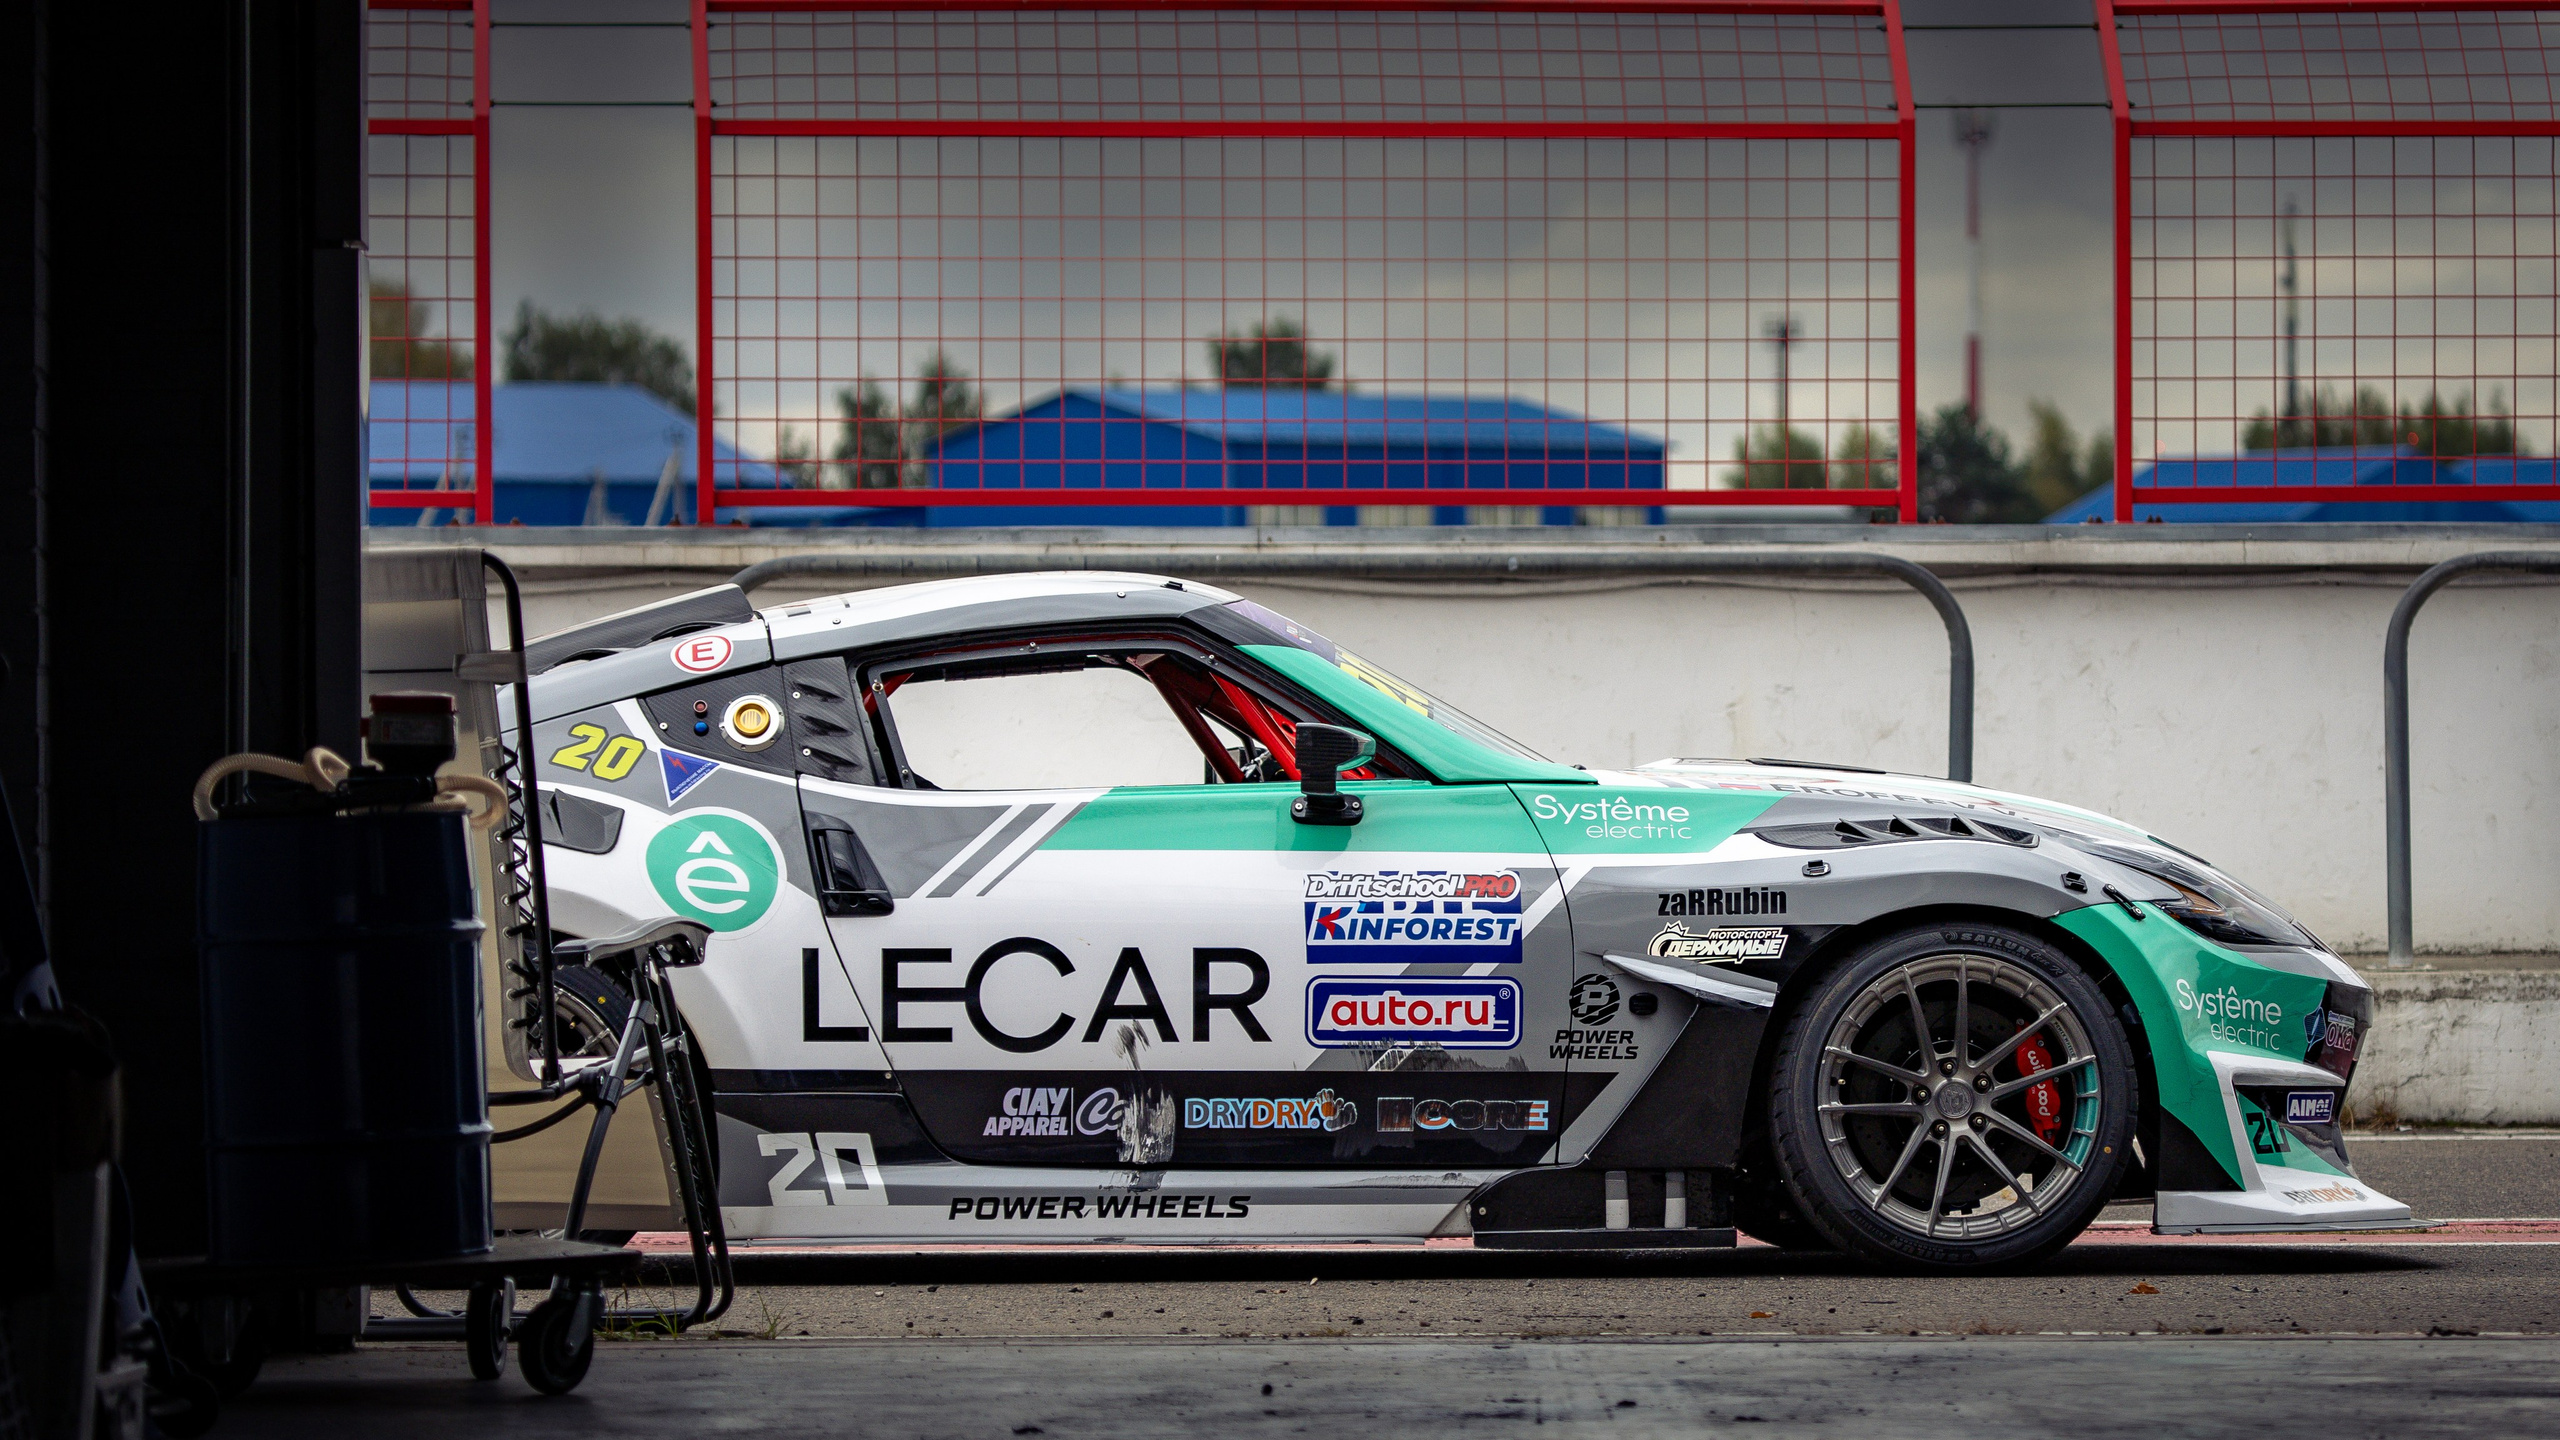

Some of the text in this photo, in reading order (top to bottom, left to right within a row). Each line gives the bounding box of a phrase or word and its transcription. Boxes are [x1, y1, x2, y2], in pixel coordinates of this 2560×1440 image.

[691, 641, 715, 662] E
[551, 723, 646, 781] 20
[1534, 794, 1690, 825] Système
[1586, 821, 1692, 839] electric
[1658, 887, 1787, 916] zaRRubin
[1313, 906, 1518, 941] KINFOREST
[1708, 930, 1778, 940] МОТОРСПОРТ
[1960, 932, 2030, 955] SAILUN
[802, 936, 1272, 1054] LECAR
[2176, 978, 2282, 1025] Système
[1331, 996, 1489, 1026] auto.ru
[1555, 1029, 1634, 1044] POWER
[2210, 1018, 2280, 1050] electric
[1549, 1045, 1639, 1060] WHEELS
[983, 1116, 1069, 1136] APPAREL
[757, 1132, 890, 1208] 20
[948, 1195, 1252, 1221] POWER WHEELS
